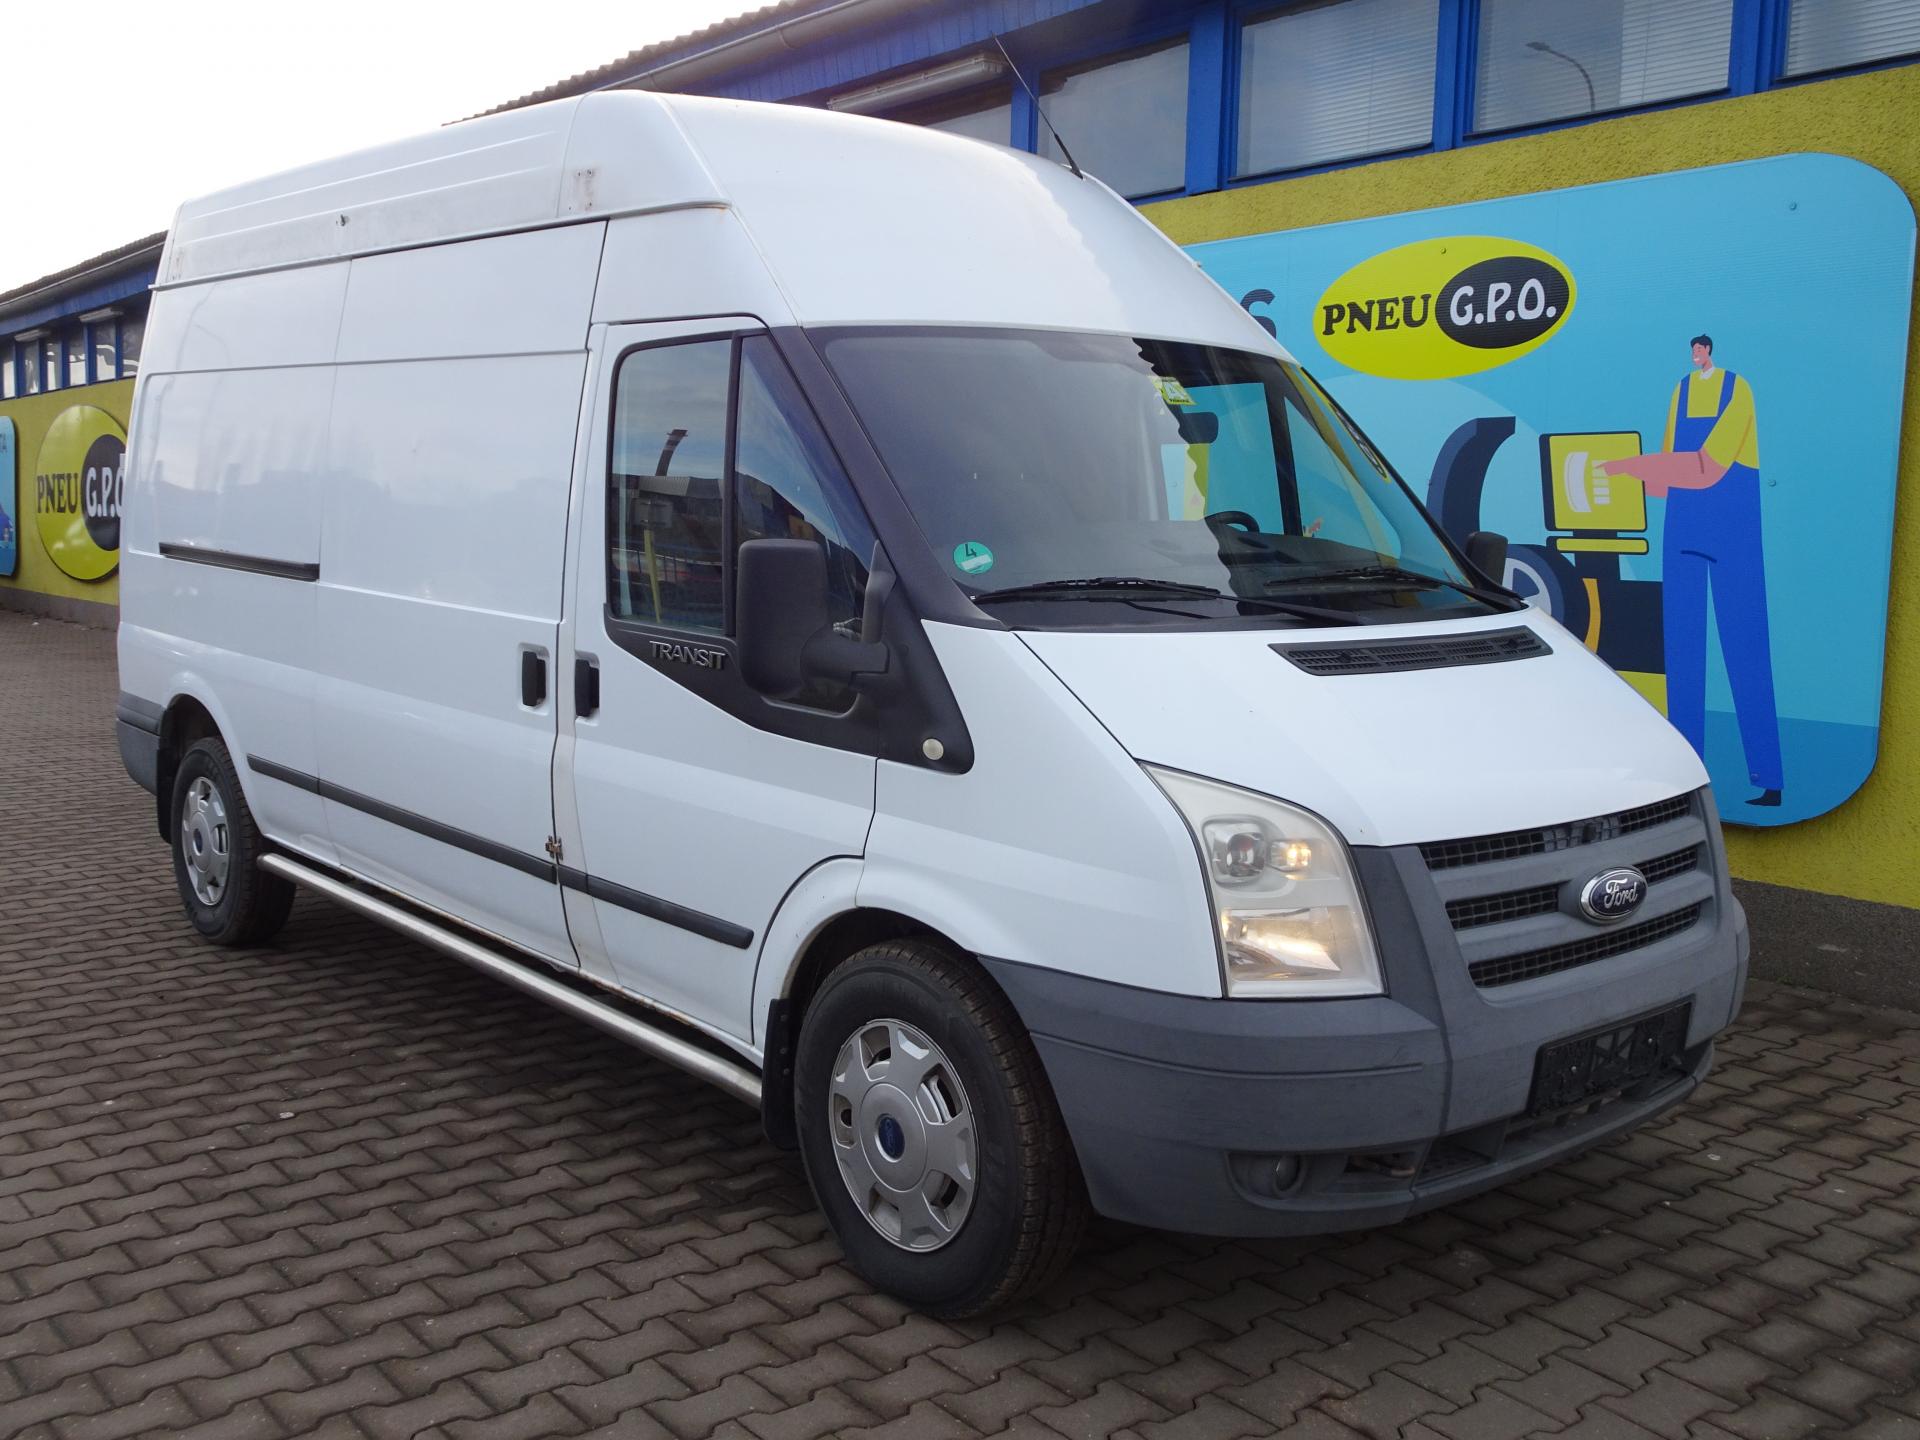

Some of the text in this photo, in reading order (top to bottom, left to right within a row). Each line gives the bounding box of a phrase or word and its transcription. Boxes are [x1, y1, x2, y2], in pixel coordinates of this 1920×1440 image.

[1323, 279, 1557, 335] PNEU G.P.O.
[37, 473, 79, 513] PNEU
[965, 544, 977, 557] 4
[650, 640, 726, 669] TRANSIT
[1604, 878, 1638, 908] Ford
